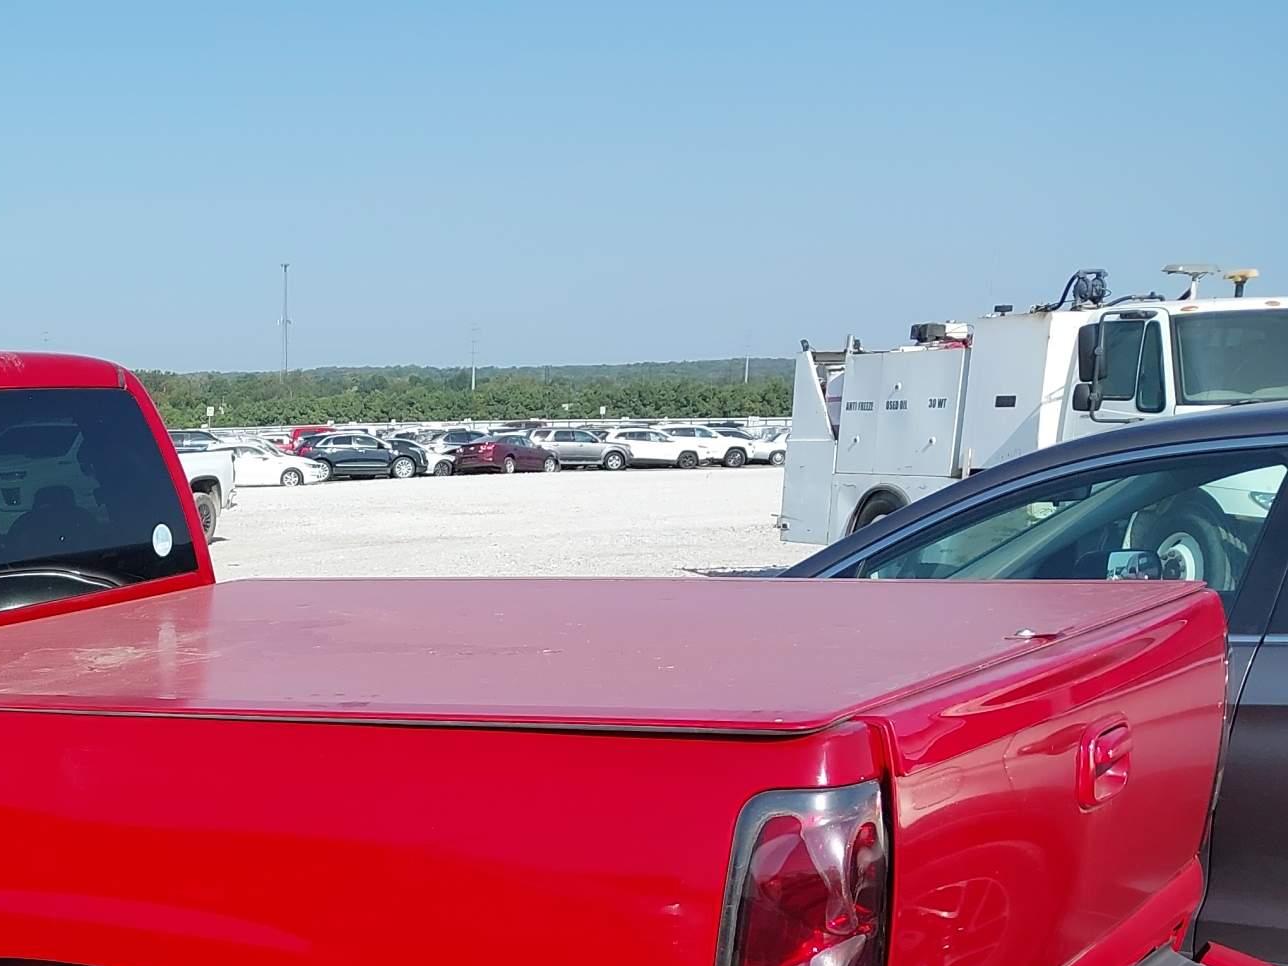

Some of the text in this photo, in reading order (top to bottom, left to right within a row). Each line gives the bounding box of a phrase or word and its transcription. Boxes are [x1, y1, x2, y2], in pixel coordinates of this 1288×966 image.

[845, 401, 874, 411] ANTI FREEZE
[886, 400, 908, 410] USED OIL
[928, 398, 947, 409] 30 WT
